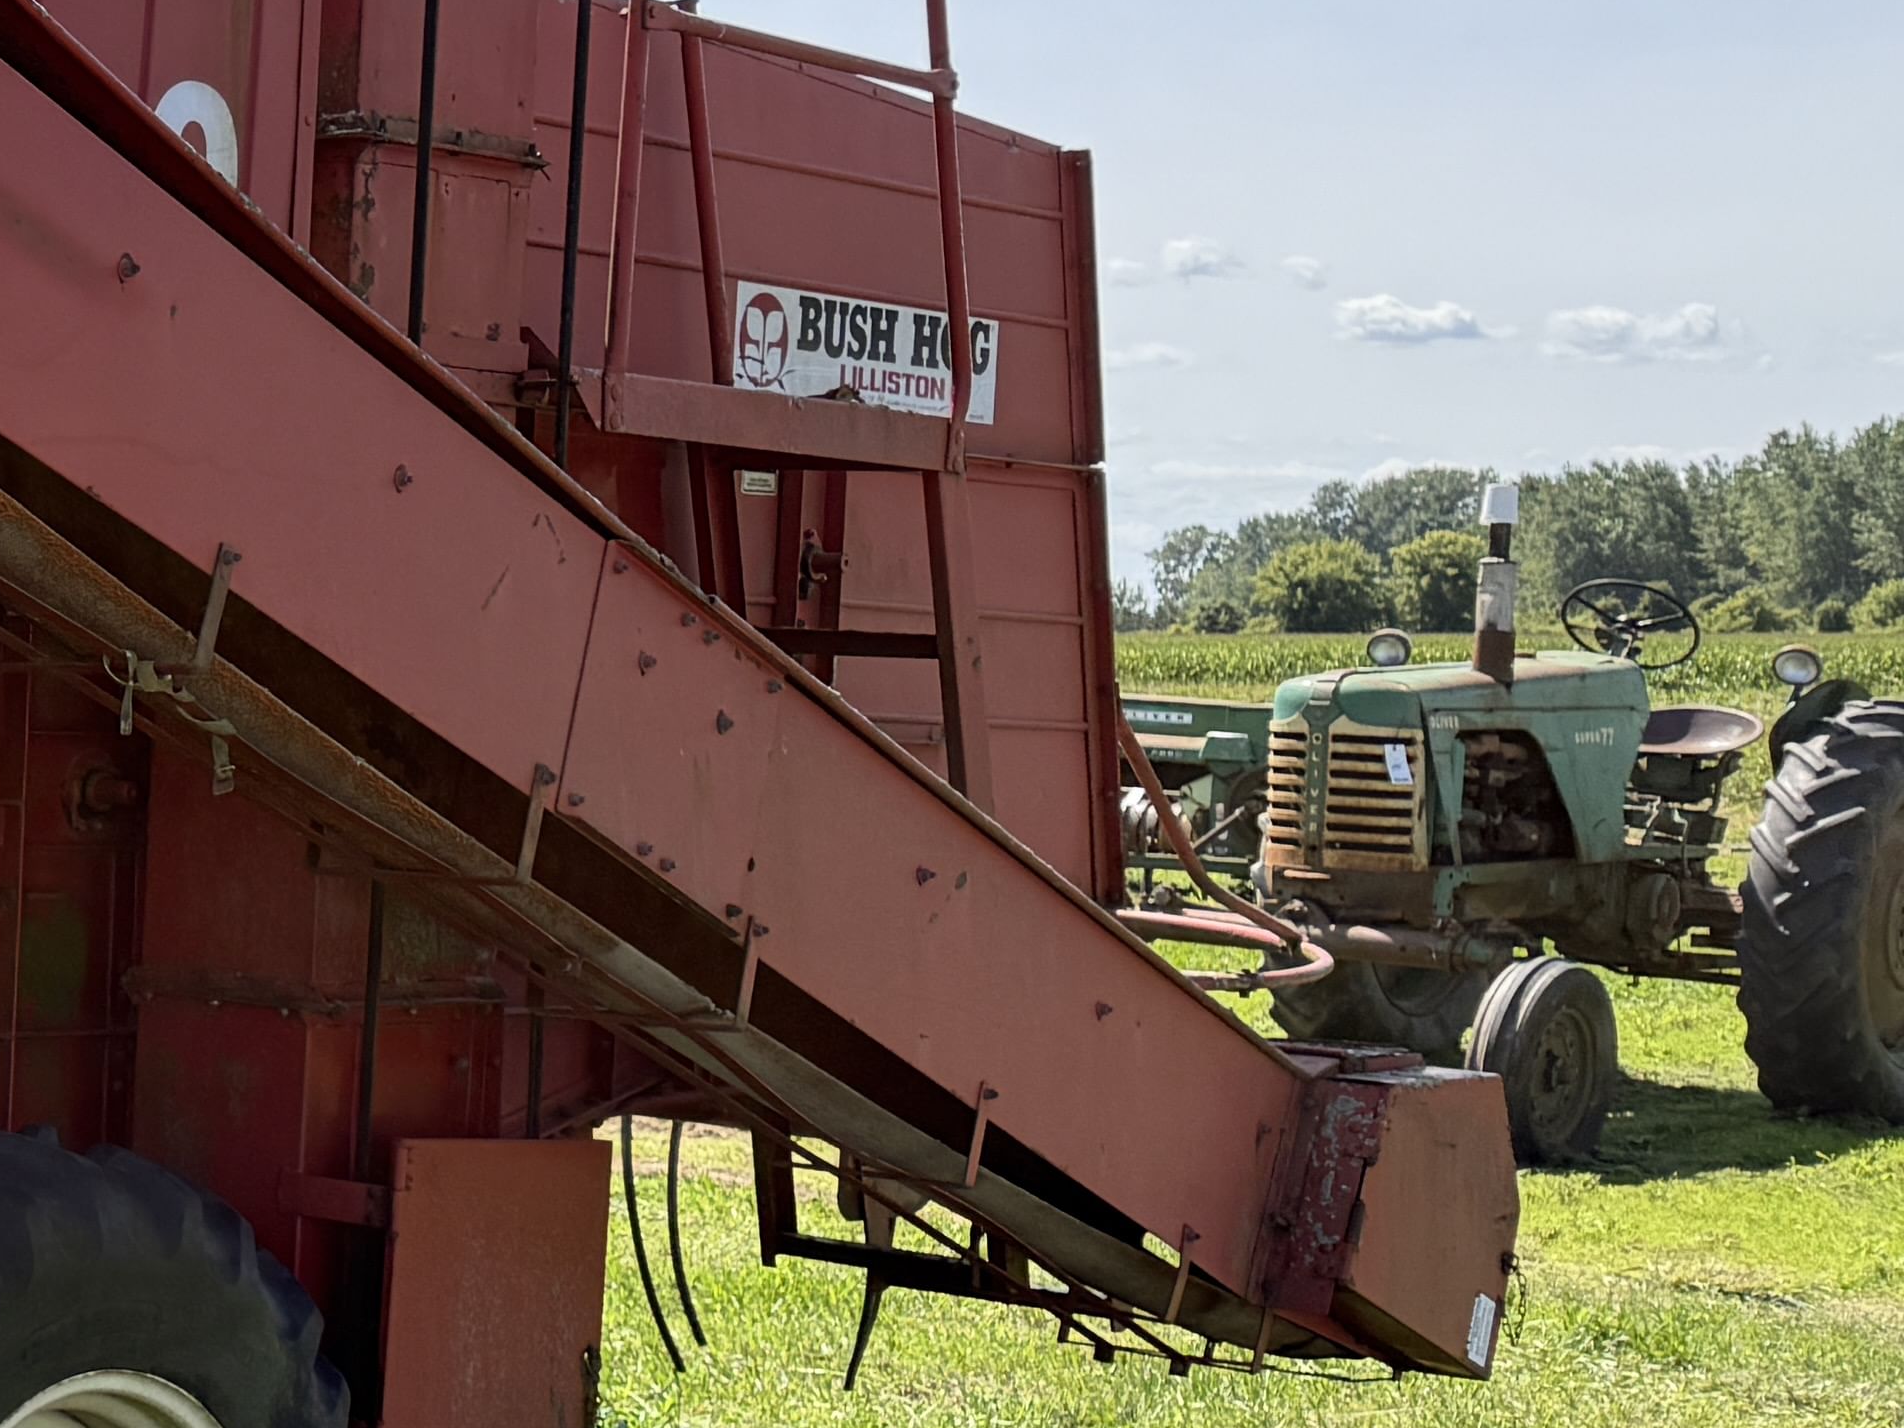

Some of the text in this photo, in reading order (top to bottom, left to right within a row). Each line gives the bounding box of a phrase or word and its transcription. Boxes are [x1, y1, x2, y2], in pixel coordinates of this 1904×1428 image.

[797, 295, 899, 363] BUSH
[840, 364, 945, 401] LILLISTON
[1308, 732, 1323, 832] OLIVER
